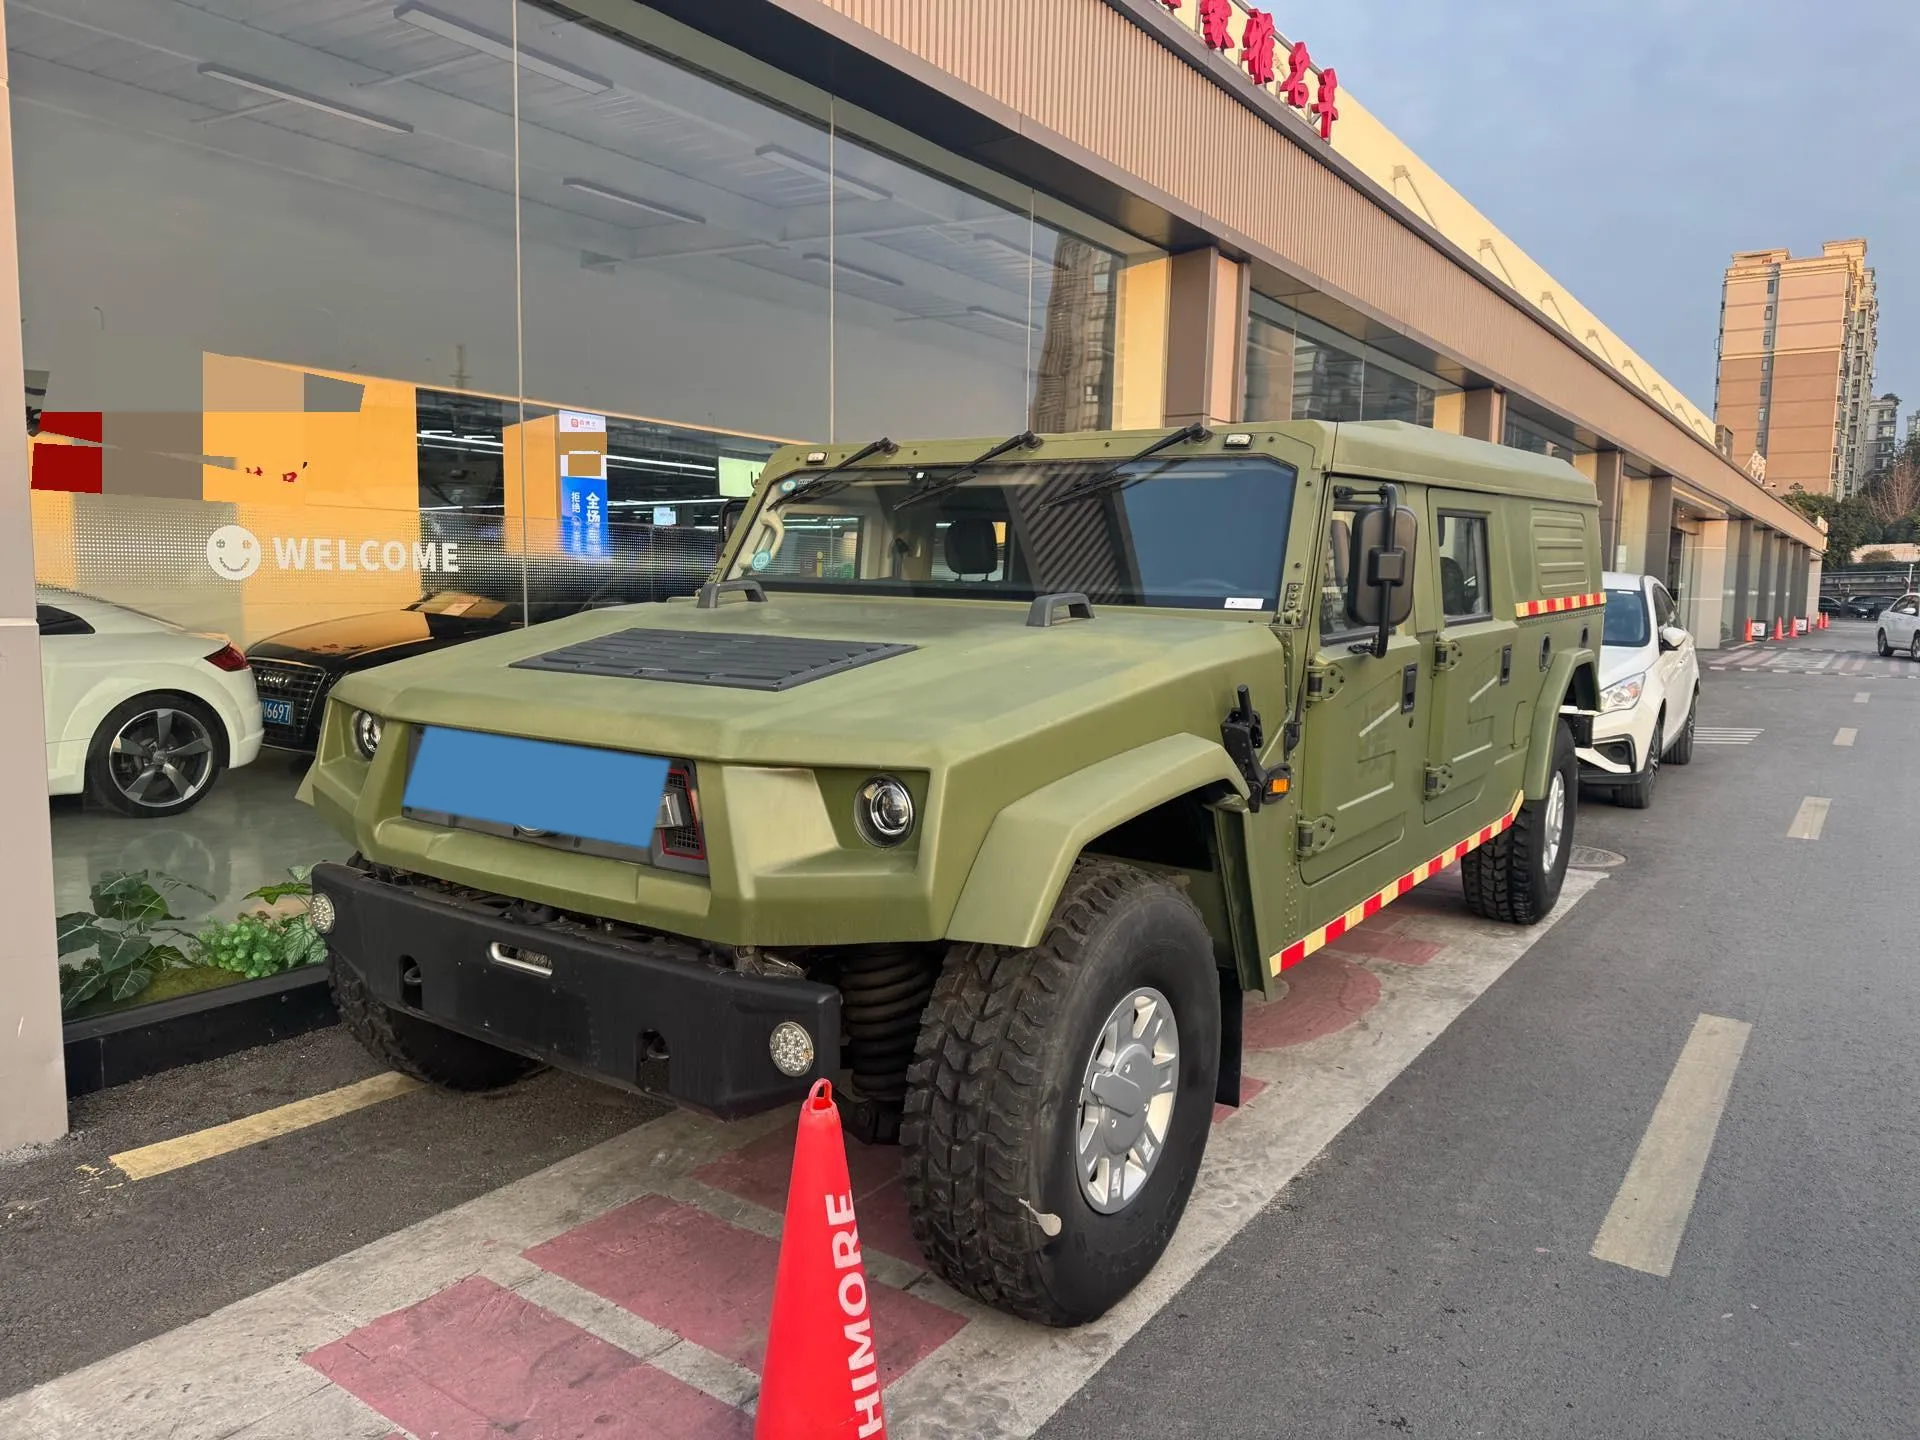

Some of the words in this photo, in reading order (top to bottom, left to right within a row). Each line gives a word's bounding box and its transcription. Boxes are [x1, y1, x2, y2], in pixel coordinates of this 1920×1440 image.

[1161, 0, 1338, 138] 豪雅名车
[272, 536, 459, 572] WELCOME
[825, 1189, 883, 1439] HIMORE
